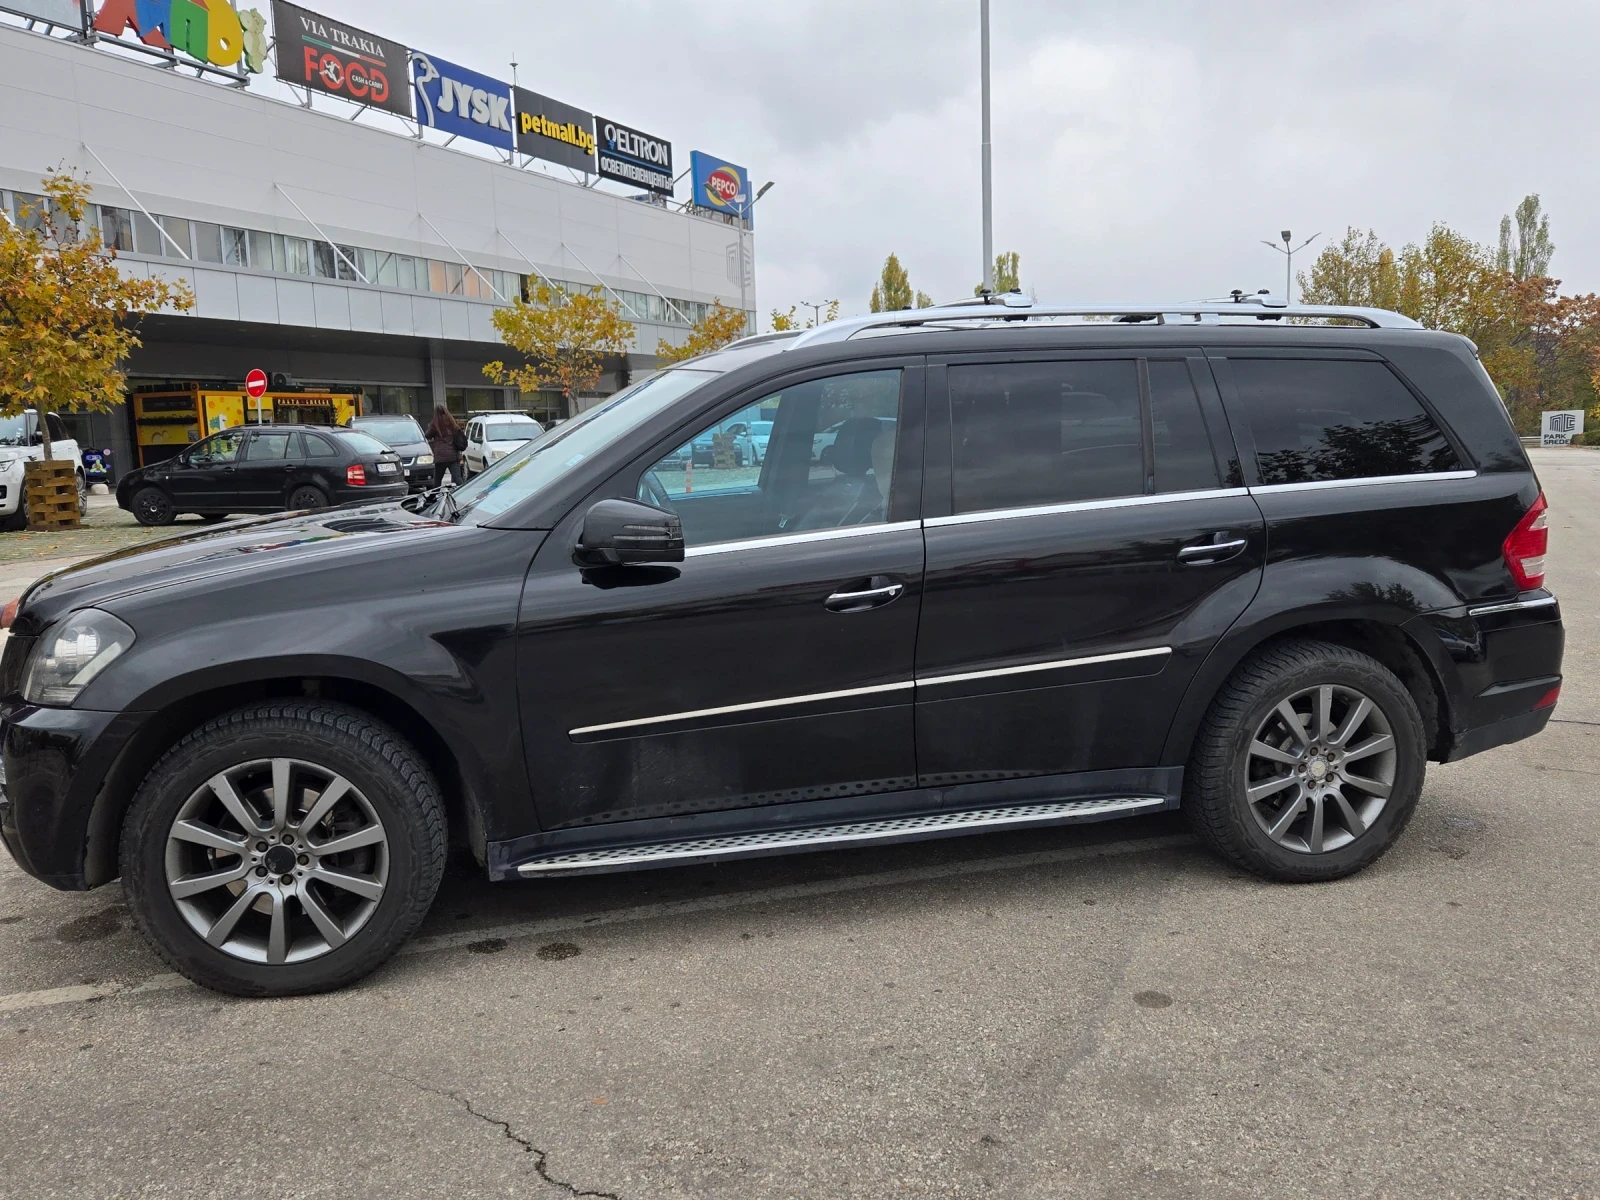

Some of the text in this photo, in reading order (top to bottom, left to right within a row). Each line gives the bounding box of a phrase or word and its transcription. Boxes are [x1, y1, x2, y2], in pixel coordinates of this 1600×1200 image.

[300, 16, 384, 57] VIA TRAKIA
[352, 75, 365, 84] CASH
[437, 77, 511, 132] JYSK
[521, 111, 595, 155] petmall.bg
[711, 176, 736, 196] PEPCO
